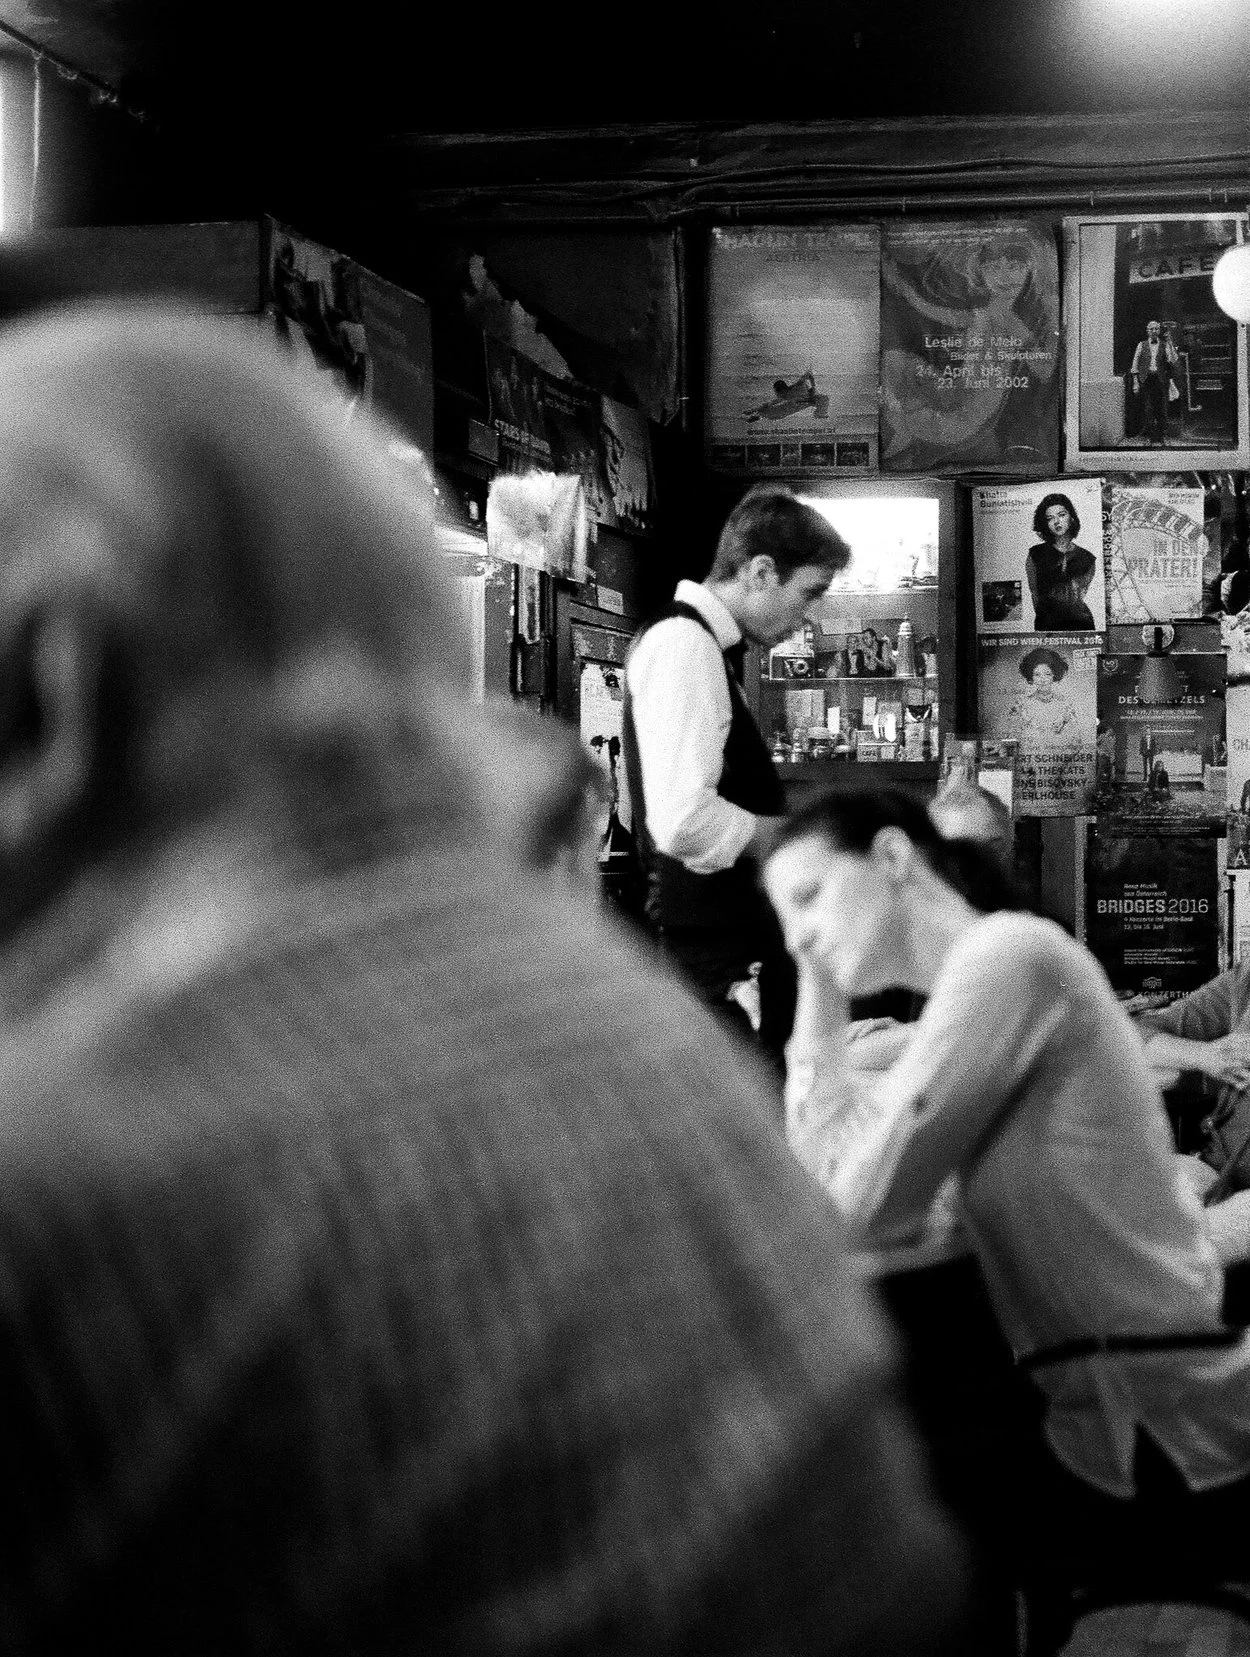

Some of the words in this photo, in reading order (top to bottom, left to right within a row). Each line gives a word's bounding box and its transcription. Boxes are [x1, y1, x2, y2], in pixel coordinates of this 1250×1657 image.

[925, 336, 963, 348] Leslie
[997, 350, 1052, 361] Skulpturen
[995, 376, 1029, 389] 2002
[999, 638, 1019, 646] SIND
[1118, 695, 1139, 705] DES
[1034, 753, 1093, 763] SCHNEIDER
[1097, 899, 1166, 914] BRIDGES
[1168, 898, 1209, 914] 2016
